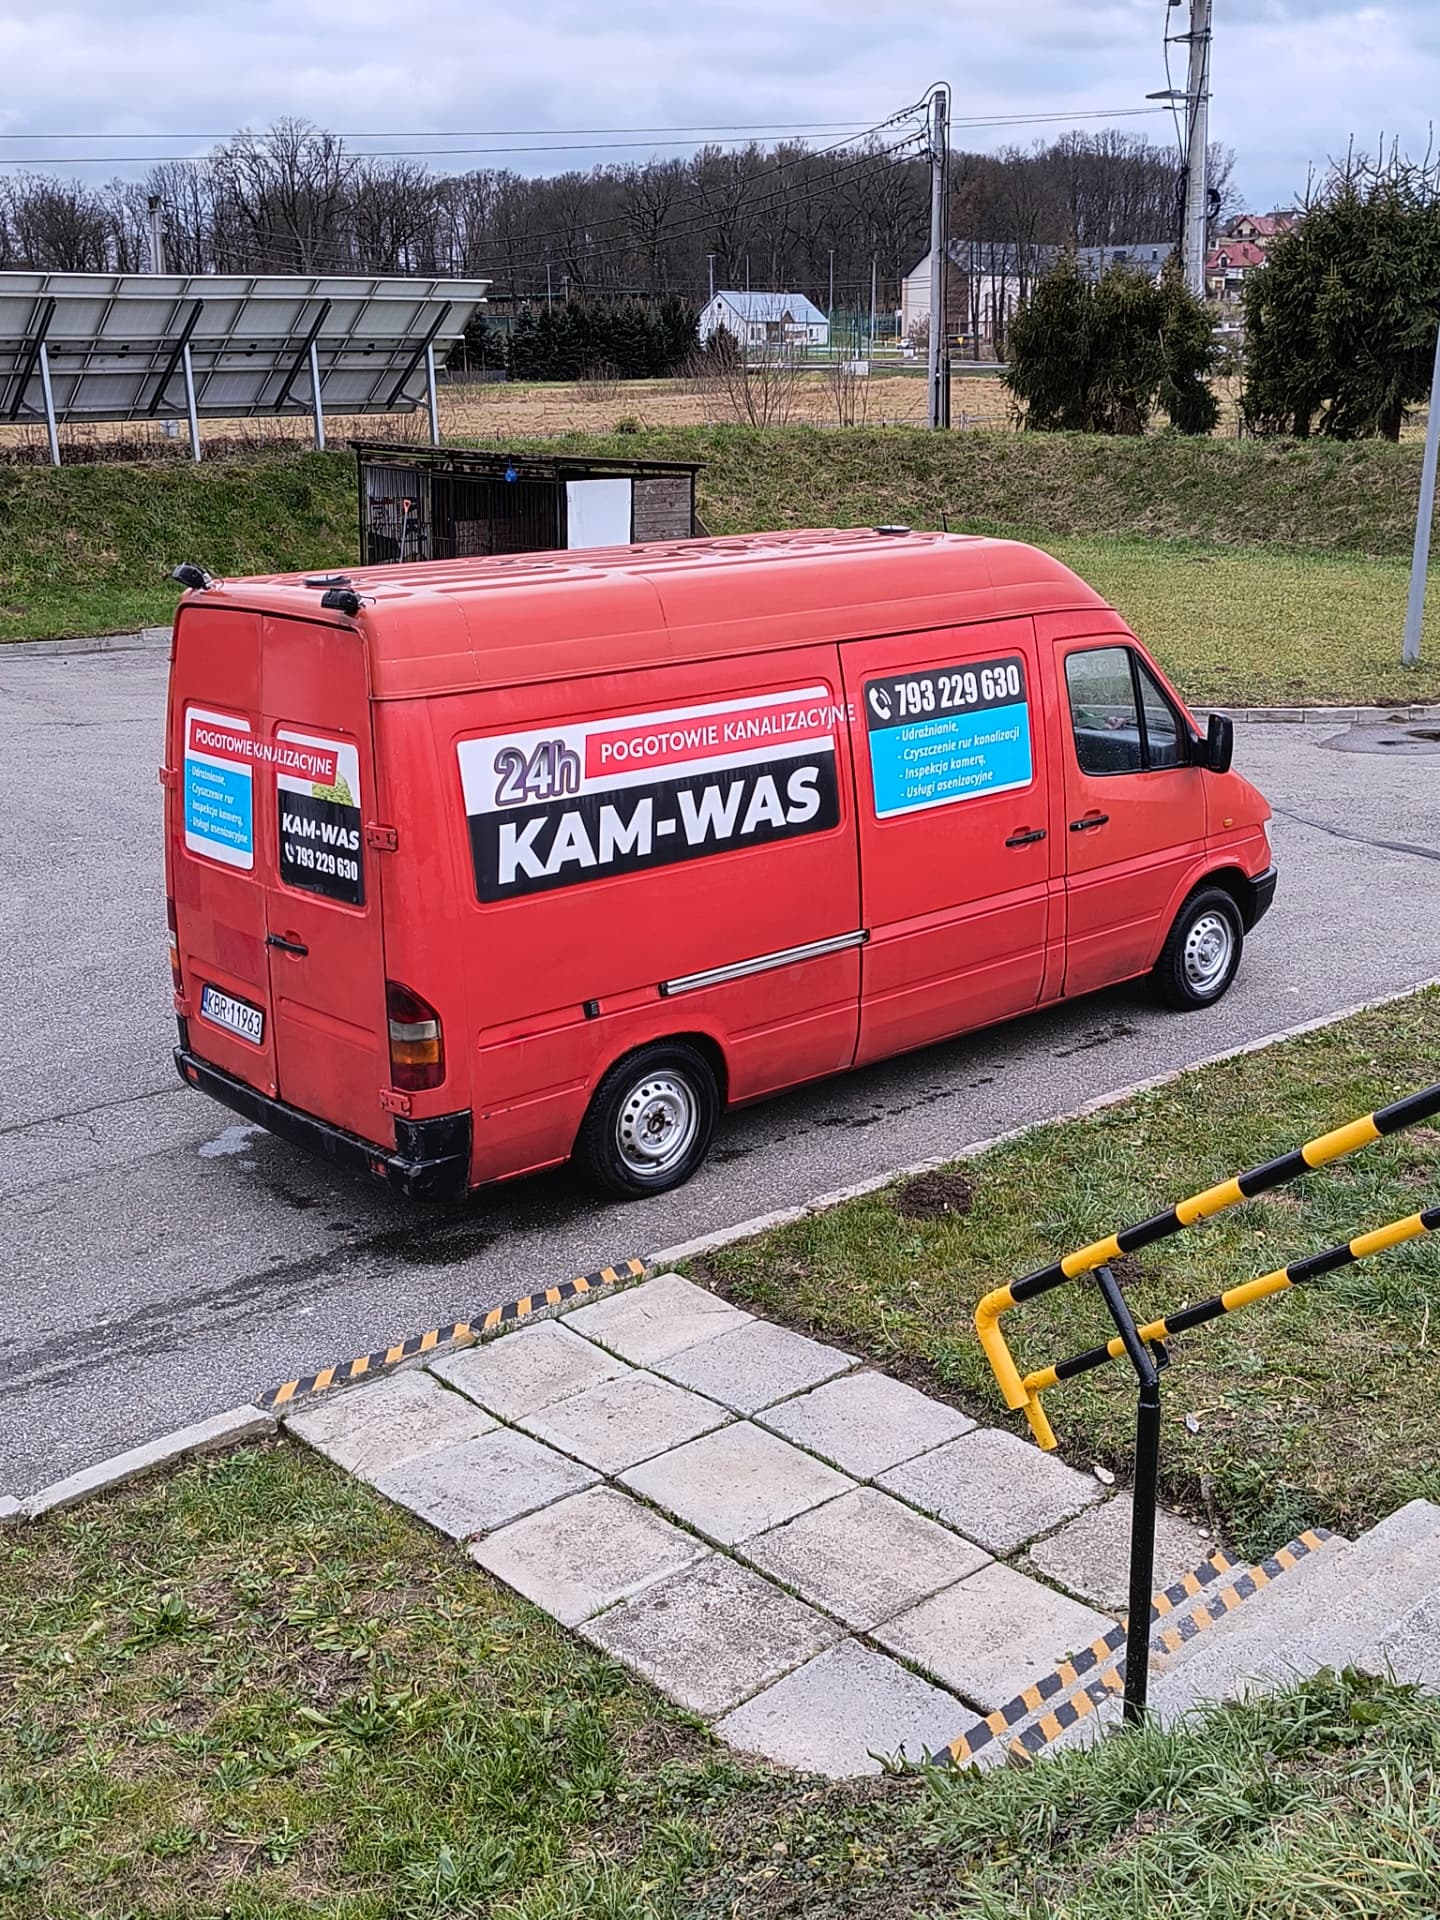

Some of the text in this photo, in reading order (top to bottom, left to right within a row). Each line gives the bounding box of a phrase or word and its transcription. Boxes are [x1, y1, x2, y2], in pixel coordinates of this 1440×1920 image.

[894, 665, 1020, 716] 793 229 630
[195, 727, 253, 756] POGOTOWIE
[600, 703, 856, 764] POGOTOWIE KANALIZACYJNE
[903, 726, 1020, 762] Czyszczenie rur kanalizacji
[494, 739, 581, 805] 24h
[905, 762, 949, 780] Inspekcja
[906, 770, 993, 799] Usługi asenizacyjne
[282, 812, 360, 850] KAM-WAS
[498, 766, 821, 885] KAM-WAS
[295, 845, 359, 881] 793 229 630
[208, 991, 261, 1035] KBR 11963
